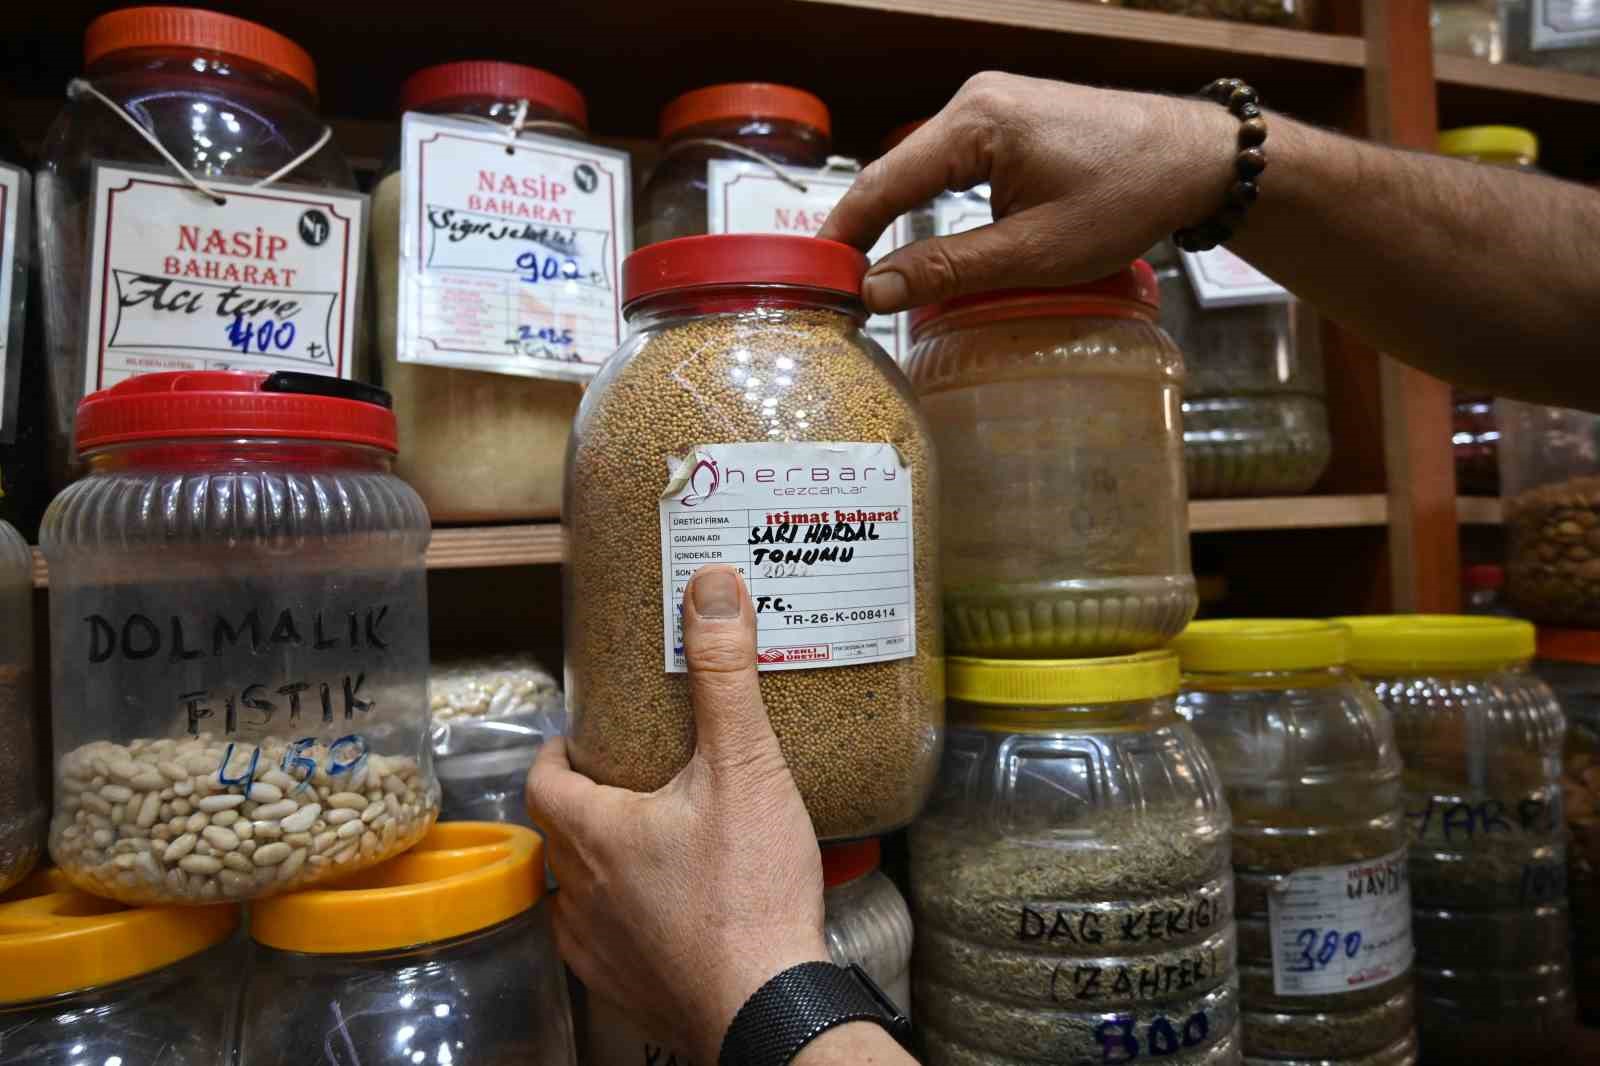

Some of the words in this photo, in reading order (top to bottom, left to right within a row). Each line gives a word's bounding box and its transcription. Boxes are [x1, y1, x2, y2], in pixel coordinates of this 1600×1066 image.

[478, 170, 567, 202] NASİP
[468, 195, 576, 224] BAHARAT
[774, 208, 826, 232] NAS
[177, 224, 289, 261] NASİP
[162, 256, 297, 288] BAHARAT
[225, 315, 296, 354] 400
[704, 515, 729, 525] FİRMA
[834, 509, 898, 523] baharat
[674, 535, 706, 543] GIDANIN
[707, 534, 720, 542] ADI
[748, 523, 799, 545] SARI
[803, 521, 880, 544] HARDAL
[753, 546, 855, 565] TOHUMU
[784, 608, 896, 625] TR-26-K-008414
[83, 605, 390, 664] DOLMALIK
[178, 672, 376, 740] FISTIK
[216, 733, 369, 801] 450
